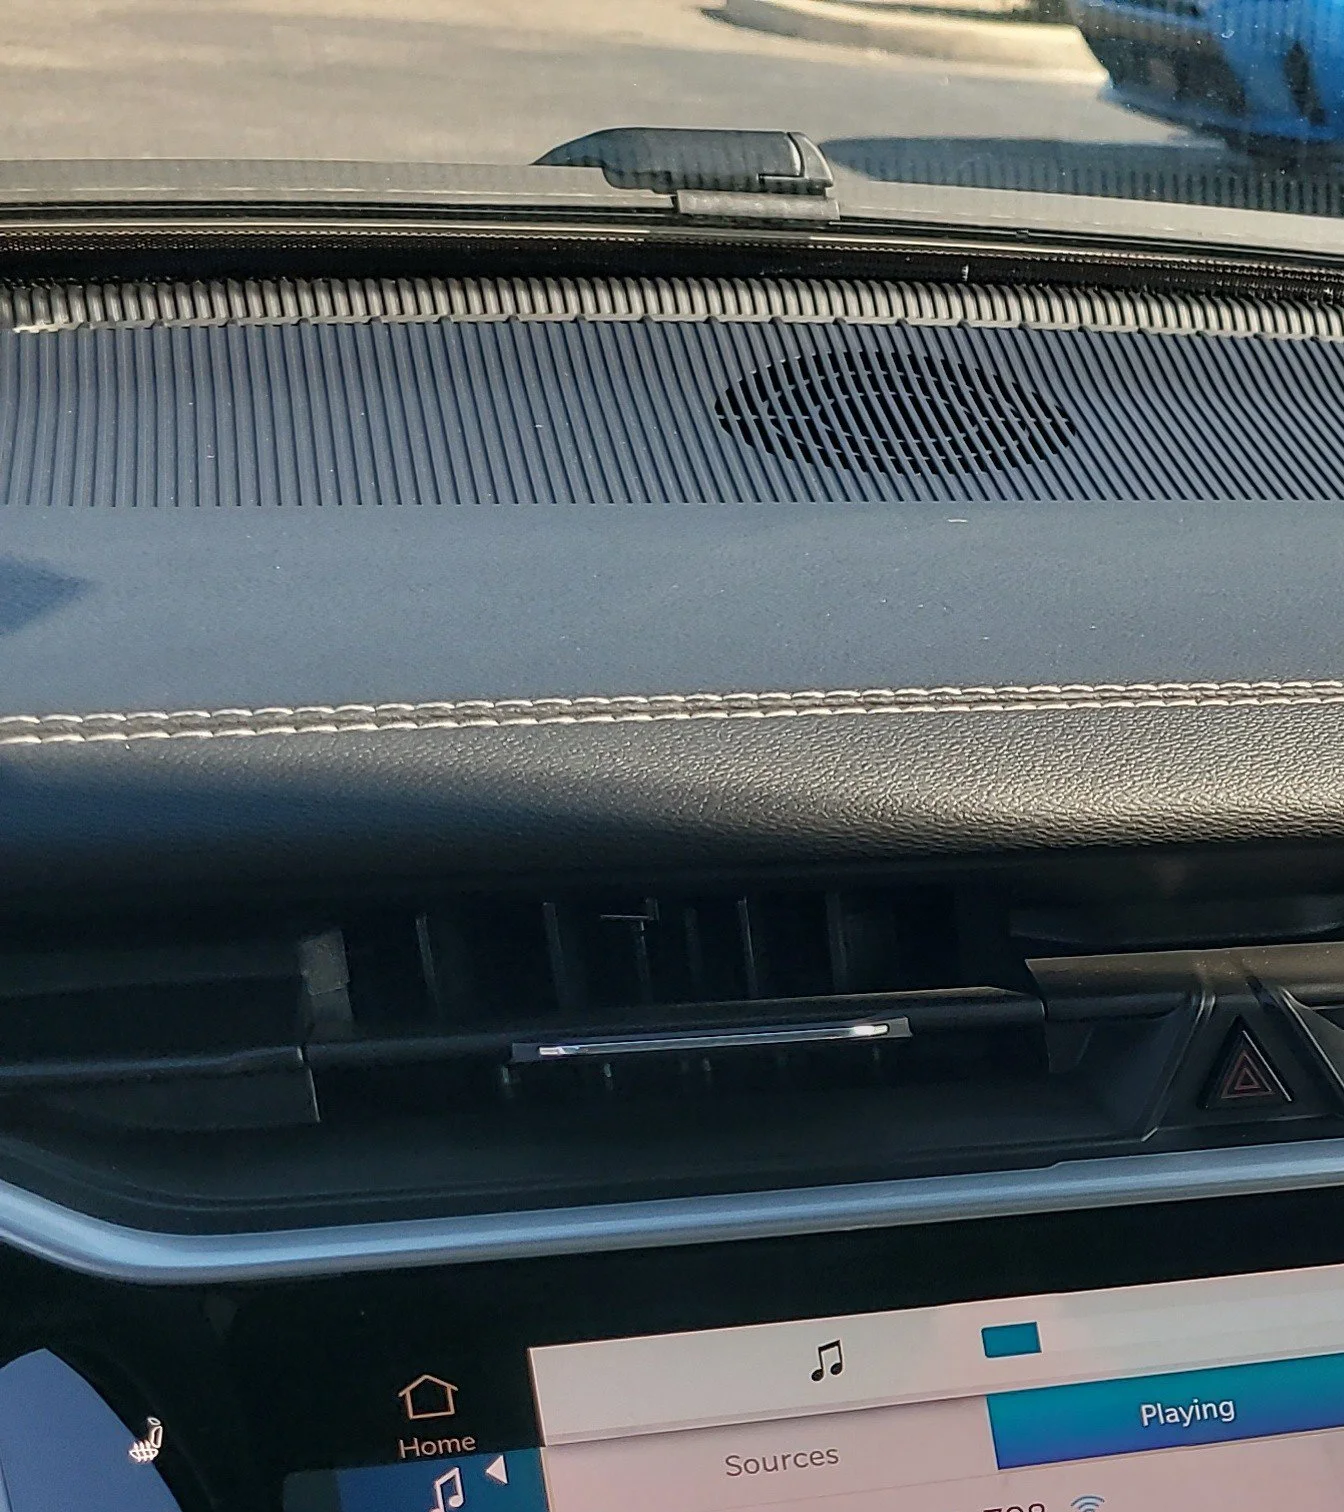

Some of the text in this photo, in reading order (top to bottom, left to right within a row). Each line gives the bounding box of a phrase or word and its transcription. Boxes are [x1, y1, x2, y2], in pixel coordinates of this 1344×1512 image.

[1141, 1398, 1236, 1428] Playing
[400, 1434, 477, 1459] Home
[725, 1447, 840, 1477] Sources
